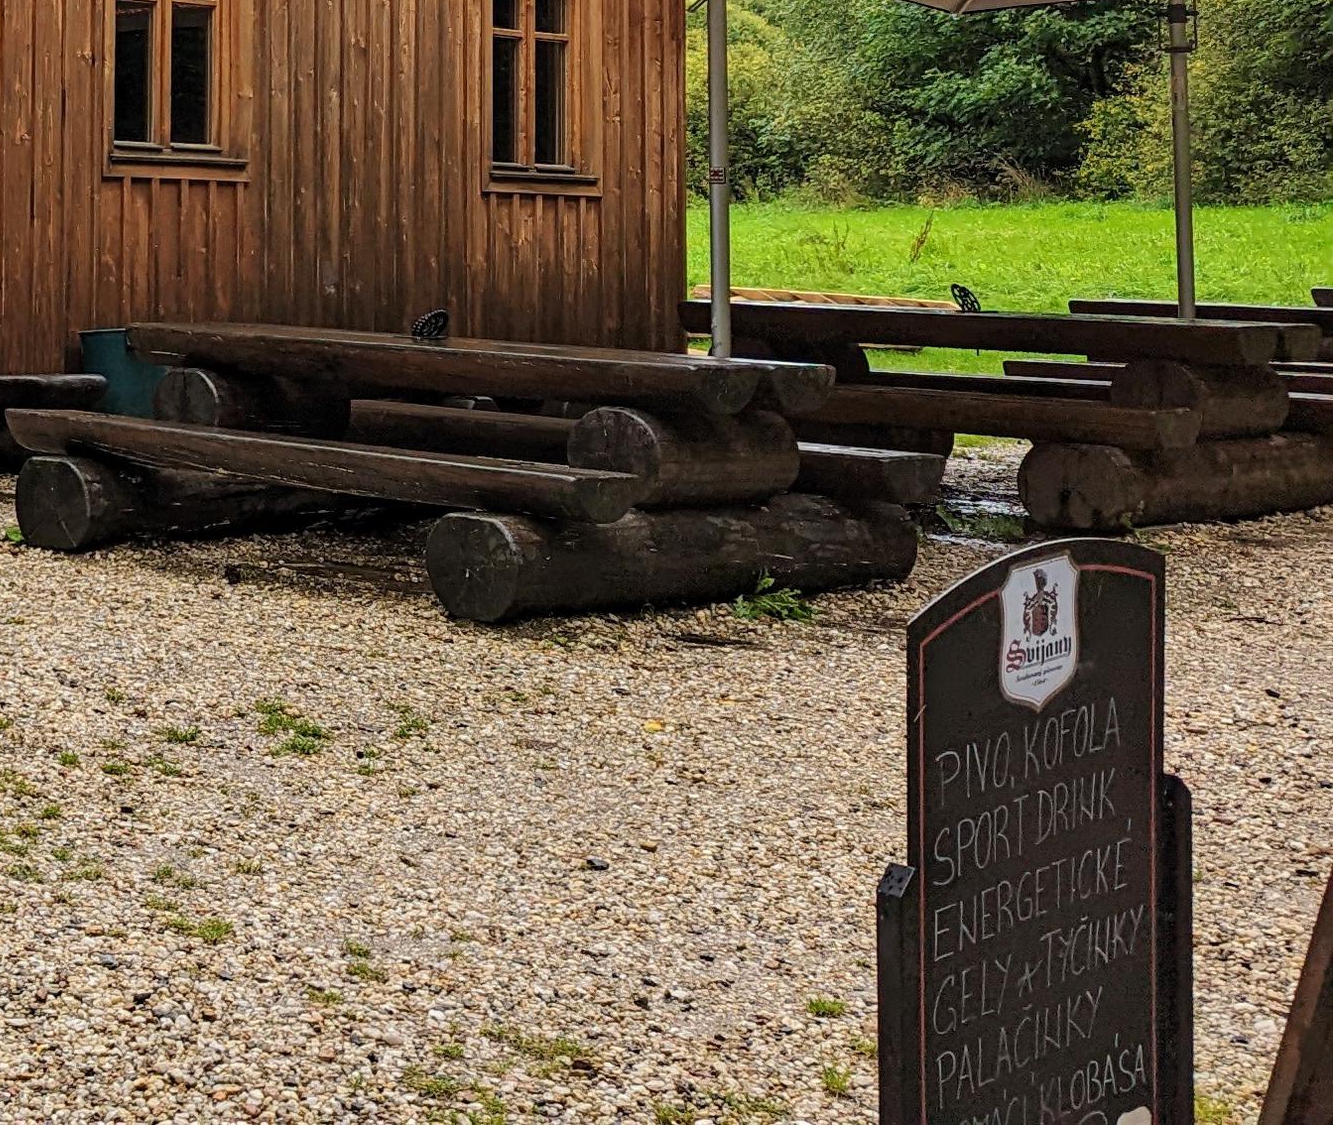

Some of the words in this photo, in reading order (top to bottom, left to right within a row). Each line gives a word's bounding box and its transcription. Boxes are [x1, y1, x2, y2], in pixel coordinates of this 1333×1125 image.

[1006, 637, 1072, 673] Svijany
[1024, 697, 1121, 779] KOFOLA
[933, 794, 1030, 886] SPORT
[1035, 767, 1116, 845] DRINK
[934, 818, 1132, 962] ENERGETICKÉ
[933, 954, 1013, 1035] GELY
[1040, 904, 1144, 988] TYČINKY
[936, 985, 1103, 1110] PALAČINKY
[1040, 1033, 1147, 1125] KLOBÁSA
